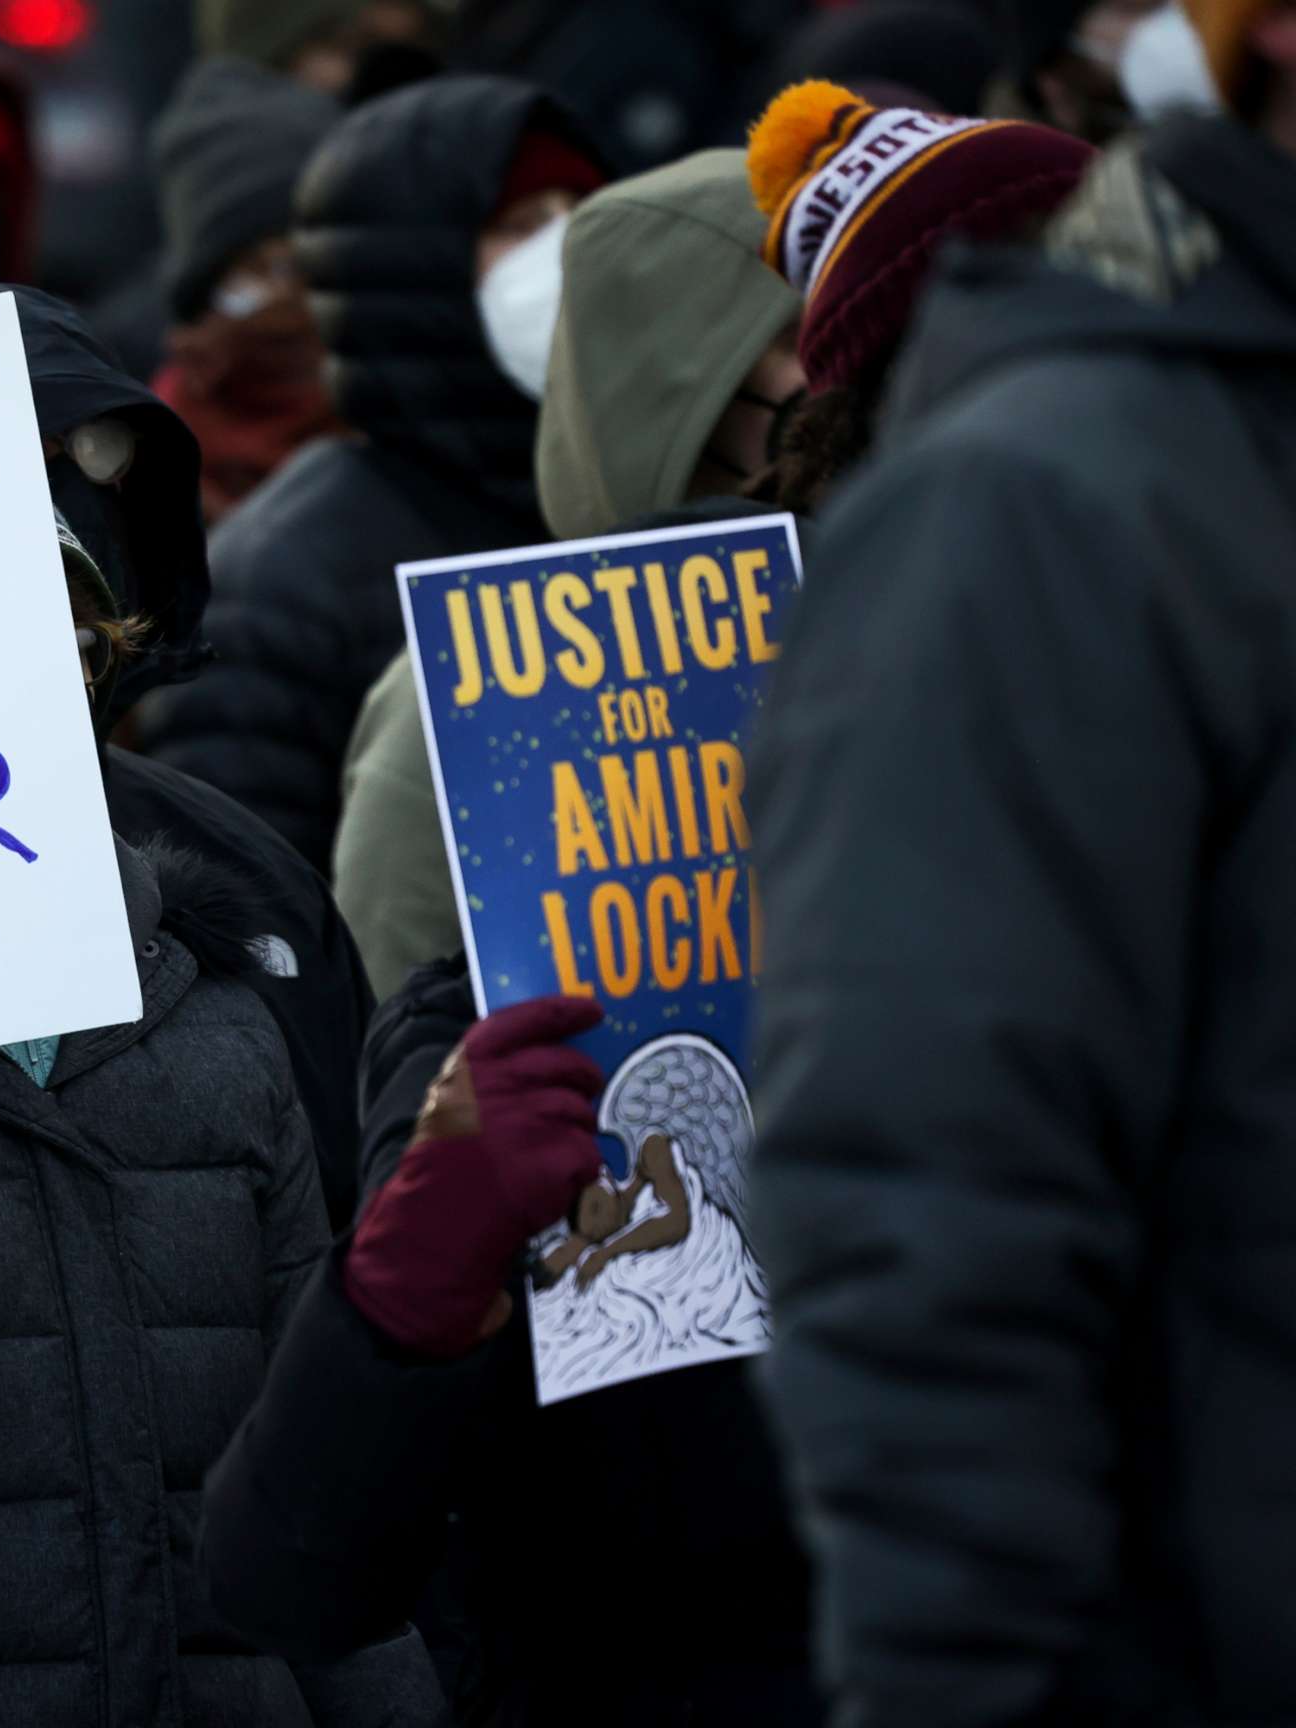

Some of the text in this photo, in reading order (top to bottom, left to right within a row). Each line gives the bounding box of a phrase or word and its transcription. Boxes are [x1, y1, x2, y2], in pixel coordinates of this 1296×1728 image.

[446, 549, 782, 706] JUSTICE
[598, 686, 673, 745] FOR
[552, 741, 751, 877] AMIR
